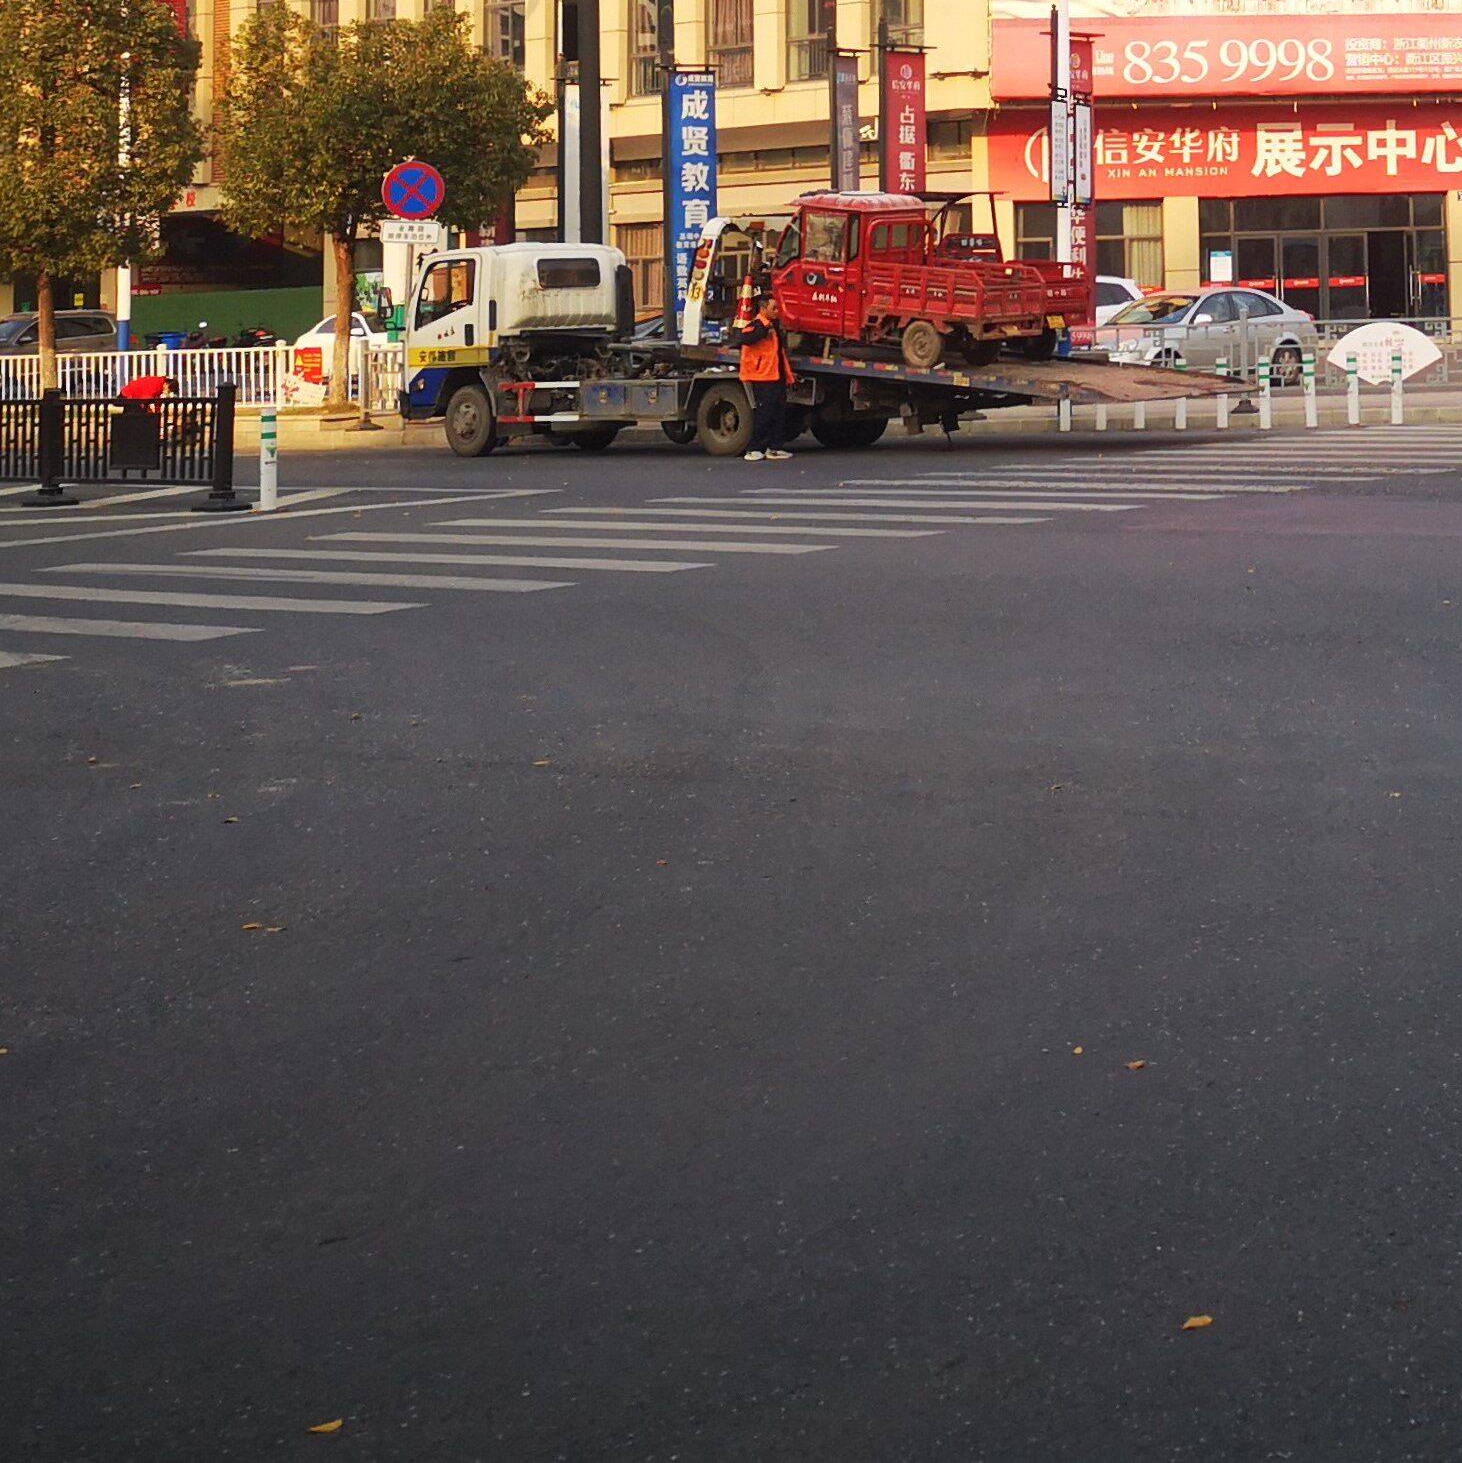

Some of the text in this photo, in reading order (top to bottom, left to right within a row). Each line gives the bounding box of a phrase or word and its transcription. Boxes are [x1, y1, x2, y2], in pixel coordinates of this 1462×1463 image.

[1122, 39, 1335, 84] 835 9998
[899, 105, 916, 145] 占据
[681, 89, 710, 228] 成贤教育
[1094, 126, 1240, 165] 信安华府
[1108, 166, 1229, 179] XIN AN MANSION
